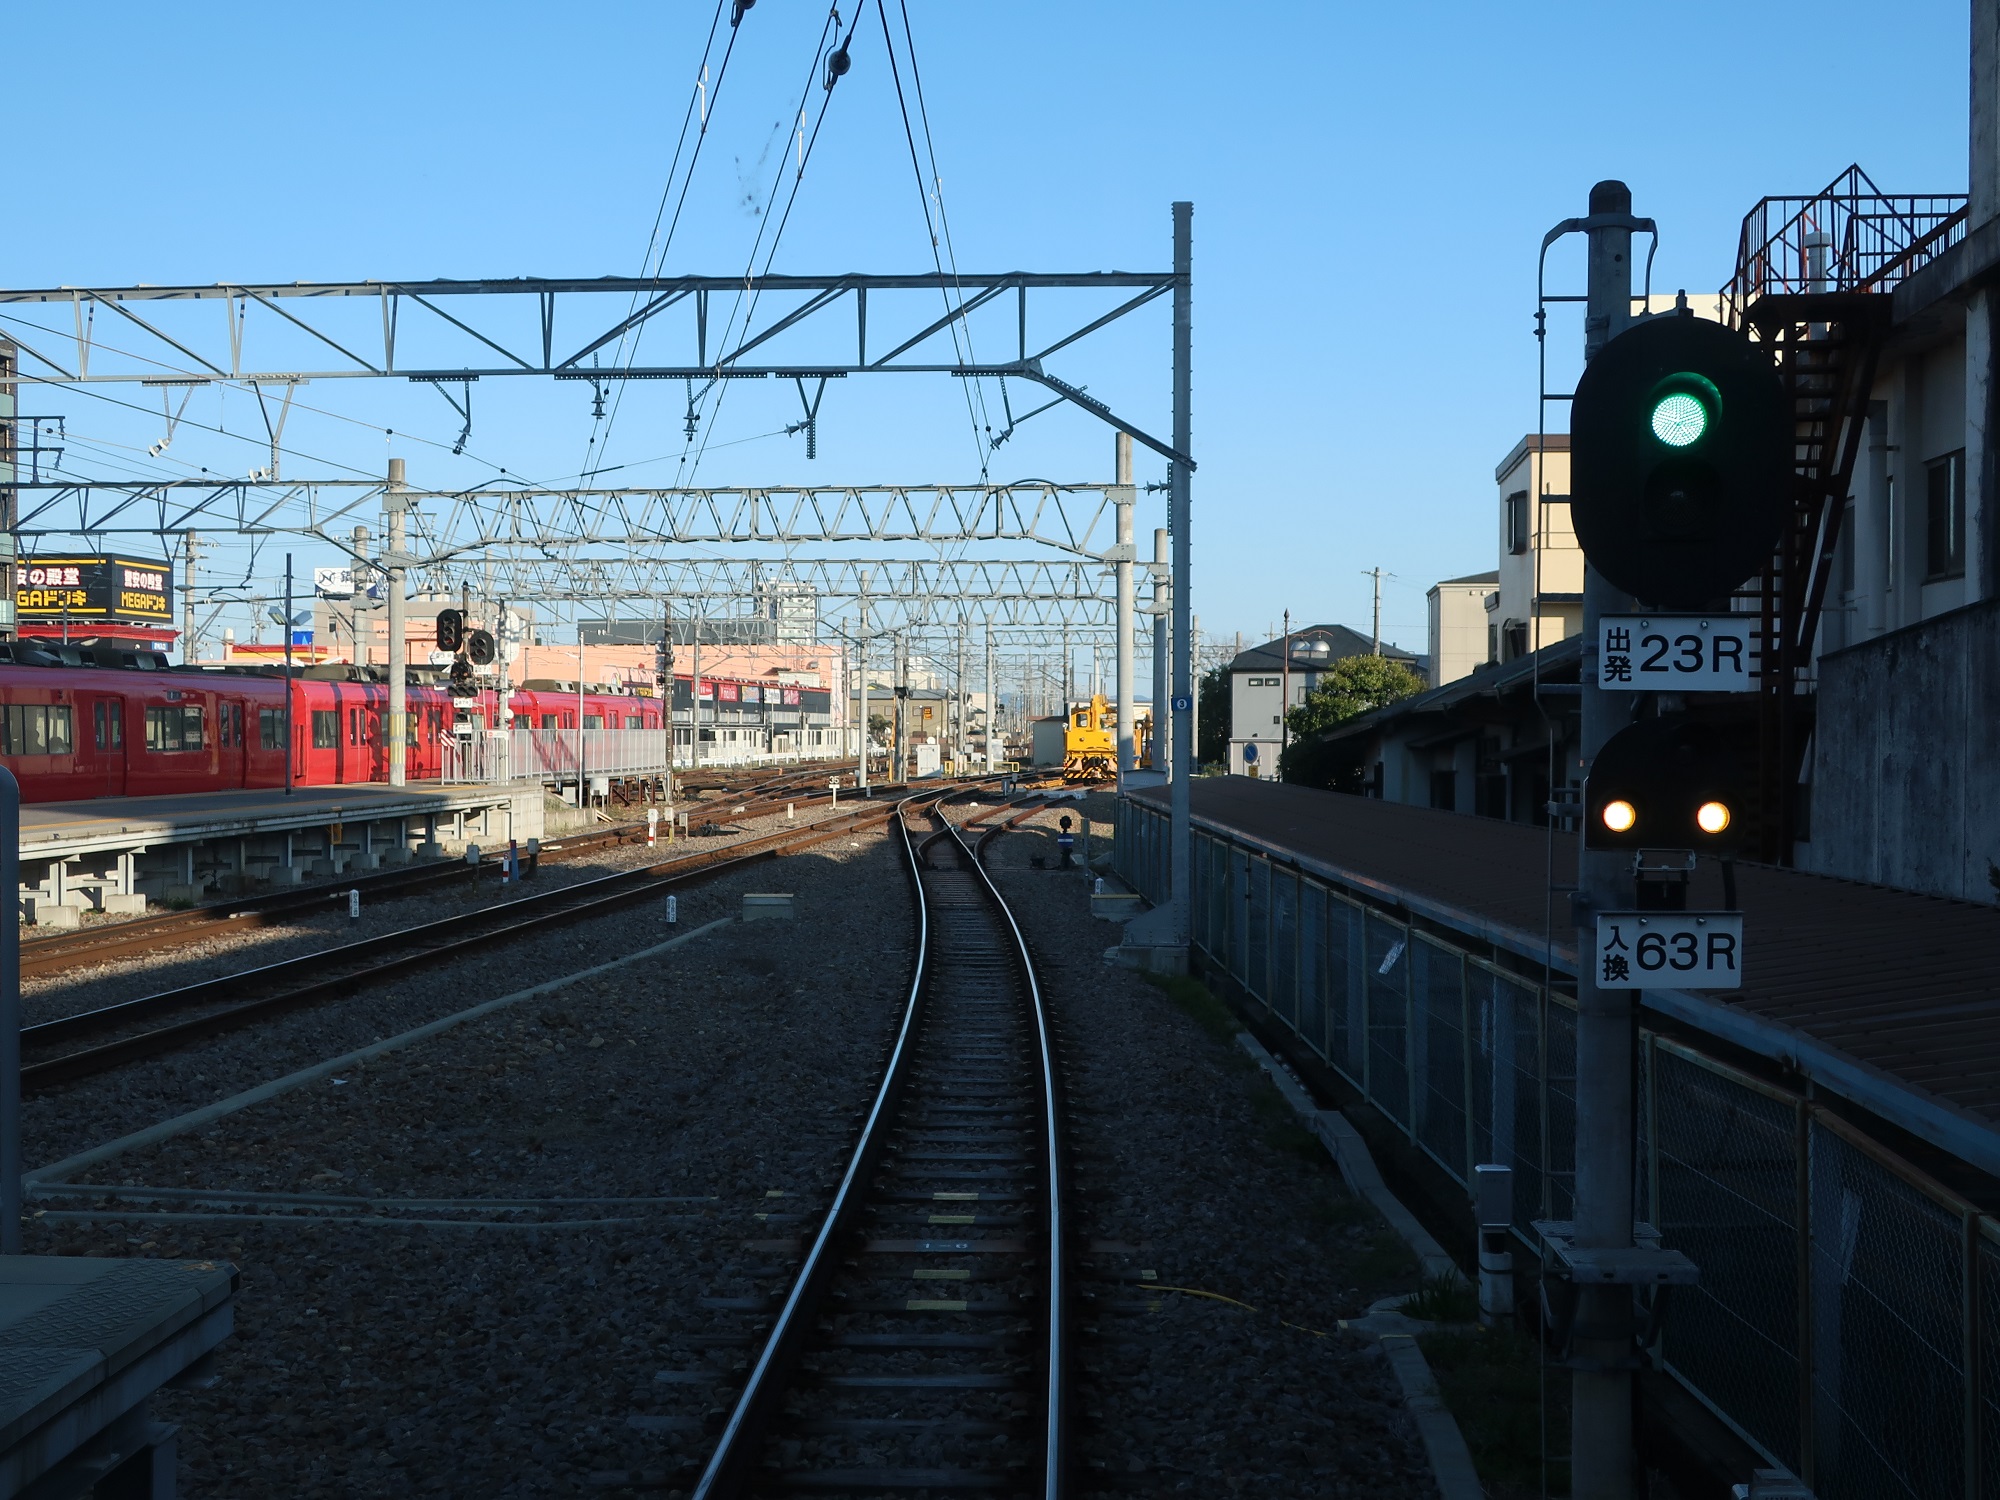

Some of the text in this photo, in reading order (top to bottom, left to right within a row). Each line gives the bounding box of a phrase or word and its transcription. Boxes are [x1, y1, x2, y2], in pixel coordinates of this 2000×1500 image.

[121, 591, 166, 611] MEGAドンキ
[1604, 626, 1743, 682] 出発 23R
[829, 775, 840, 784] 35
[1602, 925, 1736, 982] 入換 63R
